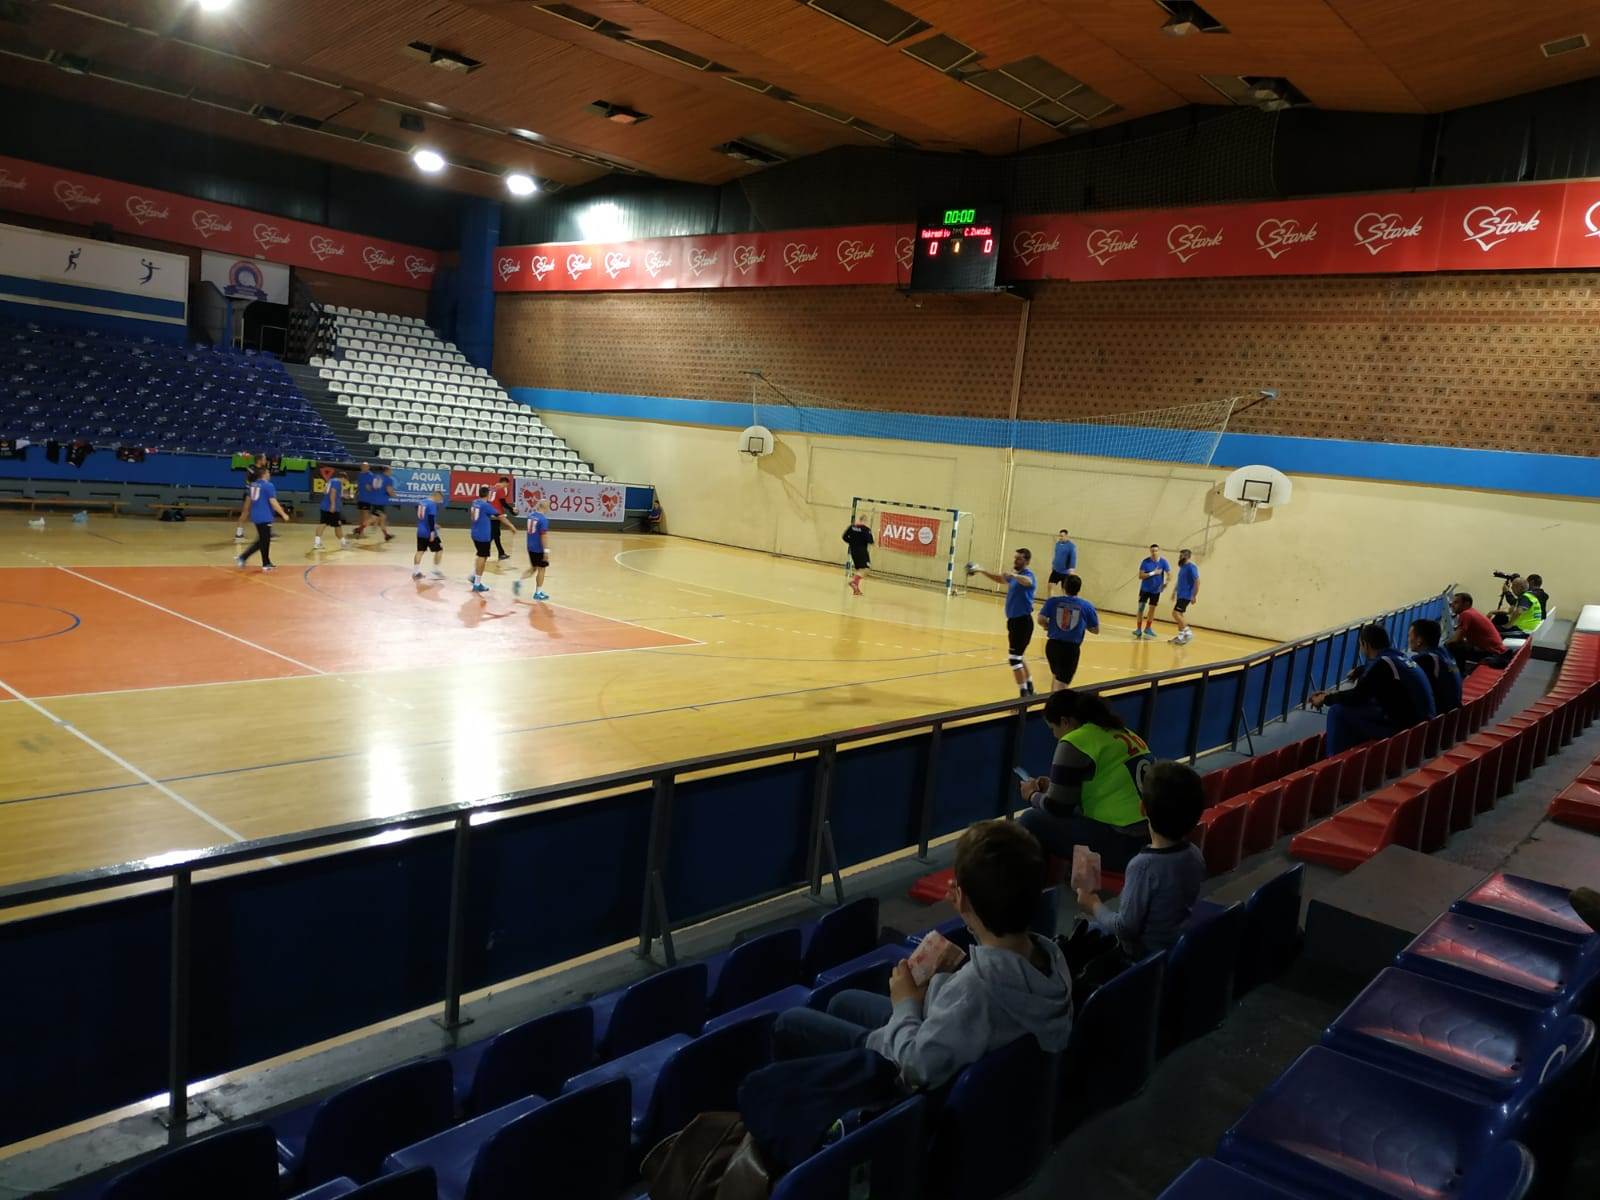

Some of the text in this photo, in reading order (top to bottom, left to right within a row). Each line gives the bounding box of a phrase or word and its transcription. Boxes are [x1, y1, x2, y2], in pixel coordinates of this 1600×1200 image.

[129, 201, 169, 218] Stark
[944, 209, 976, 224] 00:00
[194, 216, 233, 231] Stark
[1354, 216, 1423, 246] Stark
[1462, 209, 1541, 242] Stark
[255, 230, 291, 244] Stark
[1014, 232, 1062, 257] Stark
[1088, 231, 1139, 257] Stark
[1168, 228, 1224, 254] Stark
[1256, 222, 1318, 250] Stark
[312, 241, 345, 256] Stark
[838, 243, 874, 265] Stark
[929, 241, 938, 255] 0
[984, 239, 994, 253] 0
[364, 251, 396, 265] Stark
[645, 253, 673, 271] Stark
[689, 253, 721, 267] Stark
[735, 248, 767, 268] Stark
[784, 247, 819, 267] Stark
[406, 260, 435, 273] Stark
[533, 258, 556, 275] Stark
[411, 473, 442, 482] AQUA
[406, 482, 446, 492] TRAVEL
[549, 494, 595, 513] 8495
[883, 524, 915, 541] AVIS
